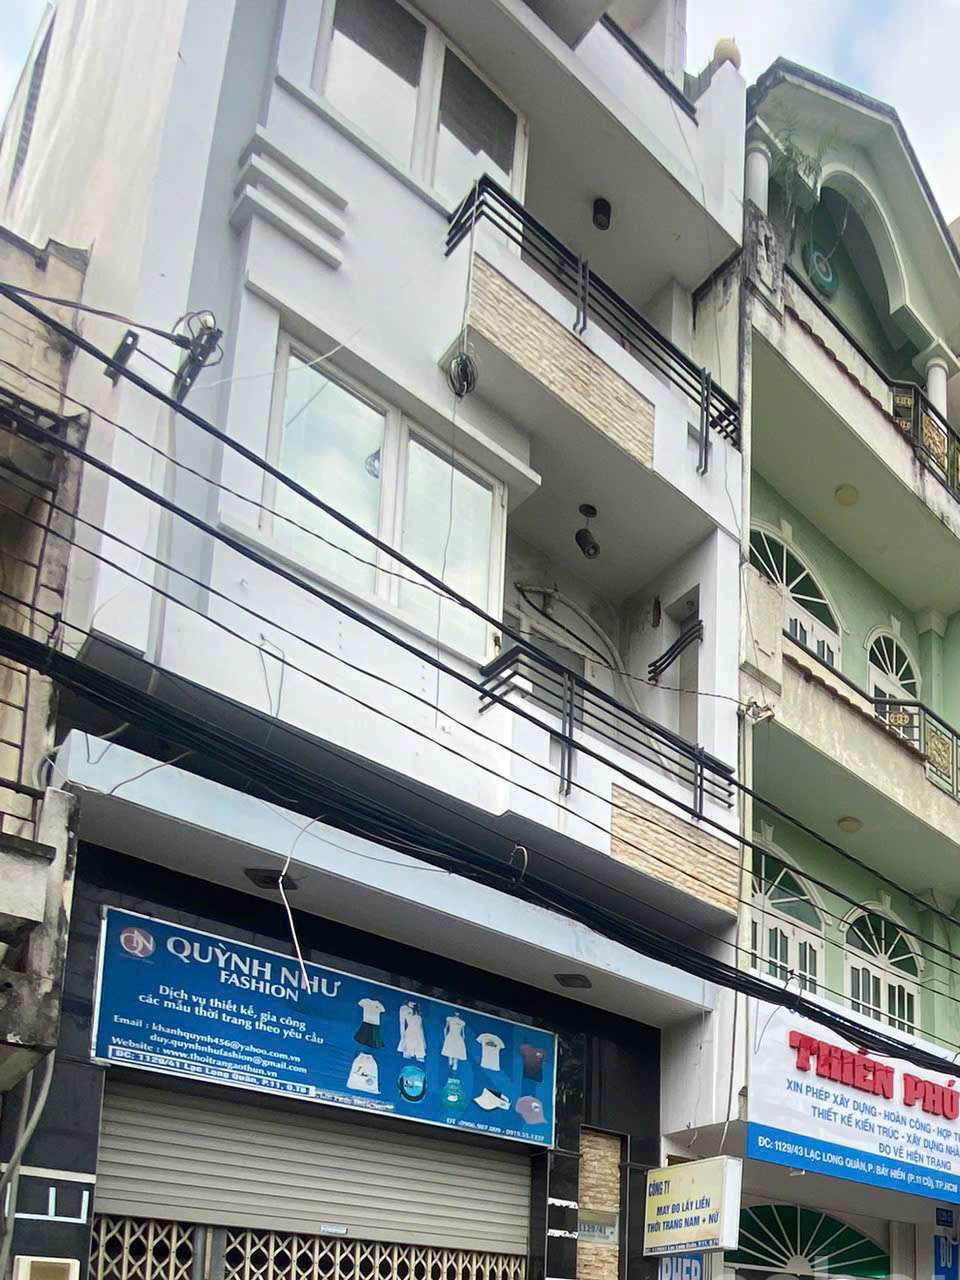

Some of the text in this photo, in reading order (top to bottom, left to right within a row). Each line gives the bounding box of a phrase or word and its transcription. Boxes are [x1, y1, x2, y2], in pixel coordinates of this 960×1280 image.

[166, 936, 342, 998] QUỲNH NHƯ
[219, 969, 299, 1002] FASHION
[113, 1014, 143, 1028] Email
[138, 993, 324, 1045] các mẫu thời trang theo yêu cầu
[159, 985, 306, 1031] Dịch vụ thiết kế, gia công
[111, 1036, 154, 1052] Website
[786, 1079, 804, 1094] XIN
[805, 1083, 831, 1102] PHÉP
[832, 1092, 850, 1108] XÂY
[853, 1100, 877, 1118] DỰNG
[884, 1110, 907, 1127] HOÀN
[909, 1117, 931, 1134] CÔNG
[937, 1126, 953, 1139] HỢP
[903, 1072, 960, 1120] PHÚ
[811, 1105, 838, 1123] THIẾT
[841, 1111, 854, 1127] KẾ
[855, 1116, 876, 1133] KIẾN
[877, 1123, 899, 1139] TRÚC
[906, 1132, 921, 1146] XÂY
[923, 1137, 944, 1153] DỰNG
[757, 1135, 774, 1149] ĐC:
[805, 1146, 822, 1162] LẠC
[823, 1150, 844, 1166] LONG
[879, 1142, 891, 1155] ĐO
[648, 1179, 671, 1197] CÔNG TY
[656, 1205, 670, 1216] MAY
[682, 1199, 694, 1212] LẤY
[663, 1218, 682, 1231] TRANG
[684, 1215, 700, 1227] NAM
